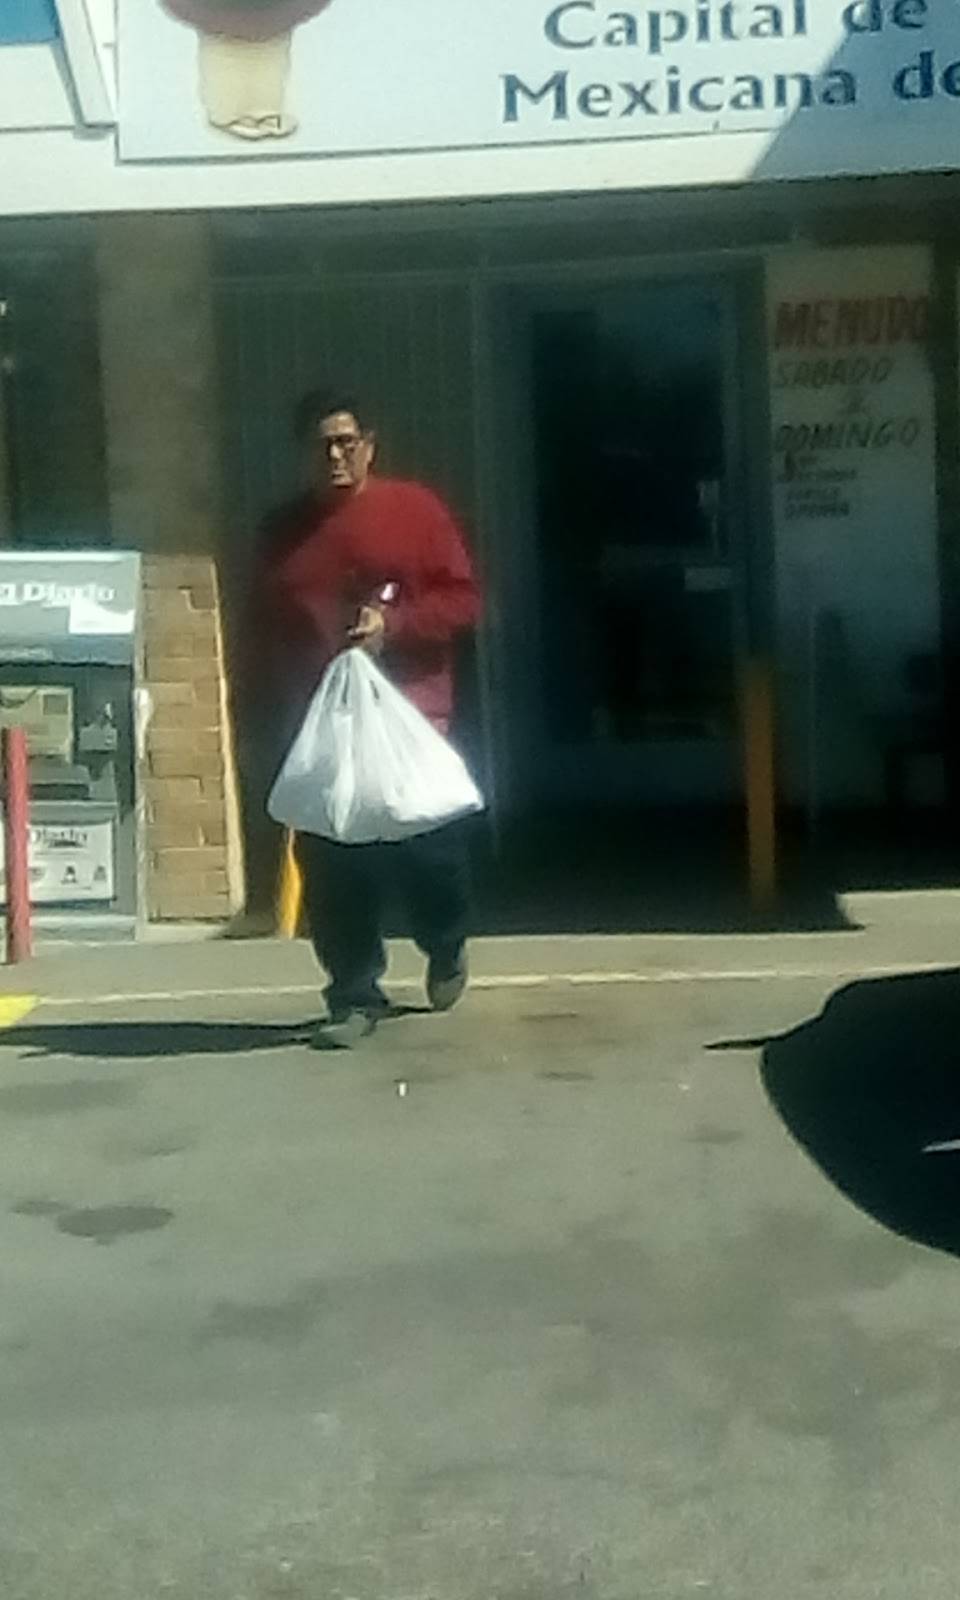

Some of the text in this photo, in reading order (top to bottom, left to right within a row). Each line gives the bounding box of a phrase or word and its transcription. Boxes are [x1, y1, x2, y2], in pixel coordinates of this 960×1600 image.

[544, 0, 928, 54] Capital de
[500, 66, 856, 123] Mexicana
[775, 418, 920, 448] DOMINGO
[22, 582, 116, 602] Diario
